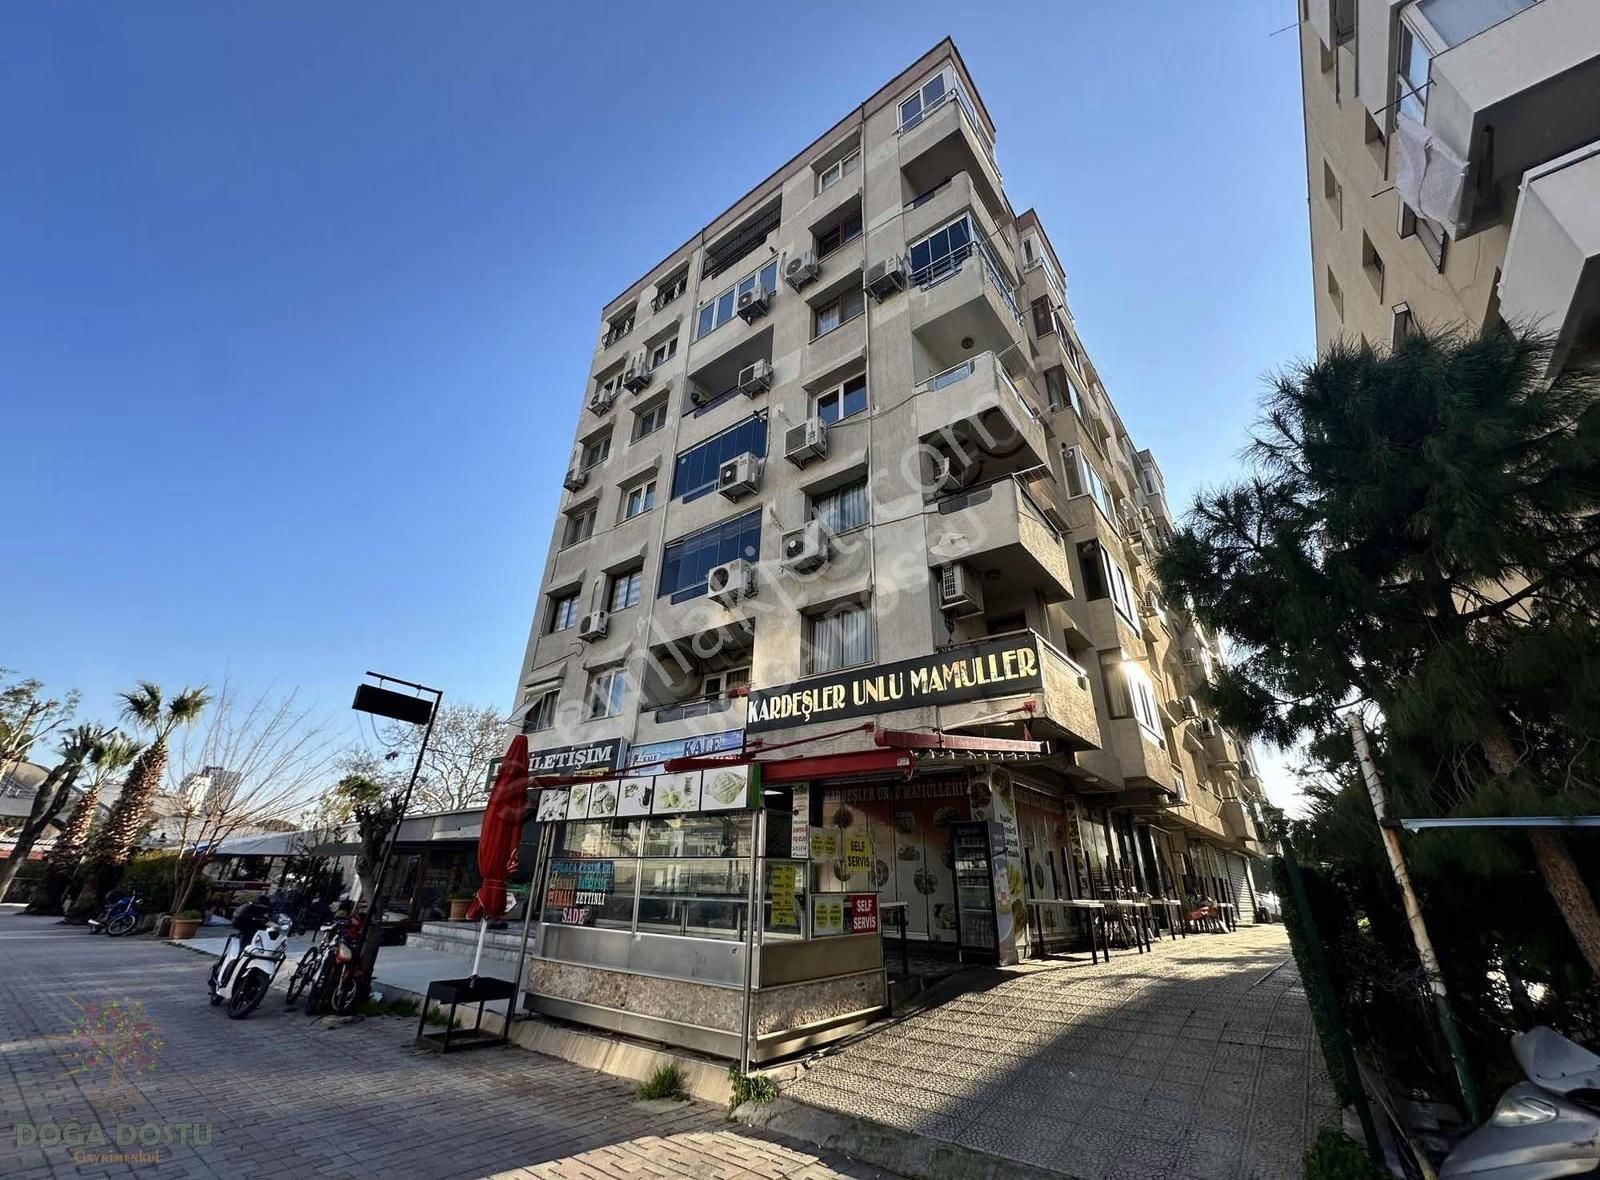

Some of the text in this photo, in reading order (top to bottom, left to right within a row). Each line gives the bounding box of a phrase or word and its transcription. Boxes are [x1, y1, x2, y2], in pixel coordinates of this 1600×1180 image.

[748, 647, 1038, 722] KARDEŞLER UNLU MAMULLER
[683, 736, 721, 756] KALE
[528, 744, 613, 771] İLETİŞİM
[850, 840, 865, 851] SELF
[856, 899, 872, 912] SELF
[561, 907, 585, 924] SADE
[853, 913, 876, 930] SERVİS
